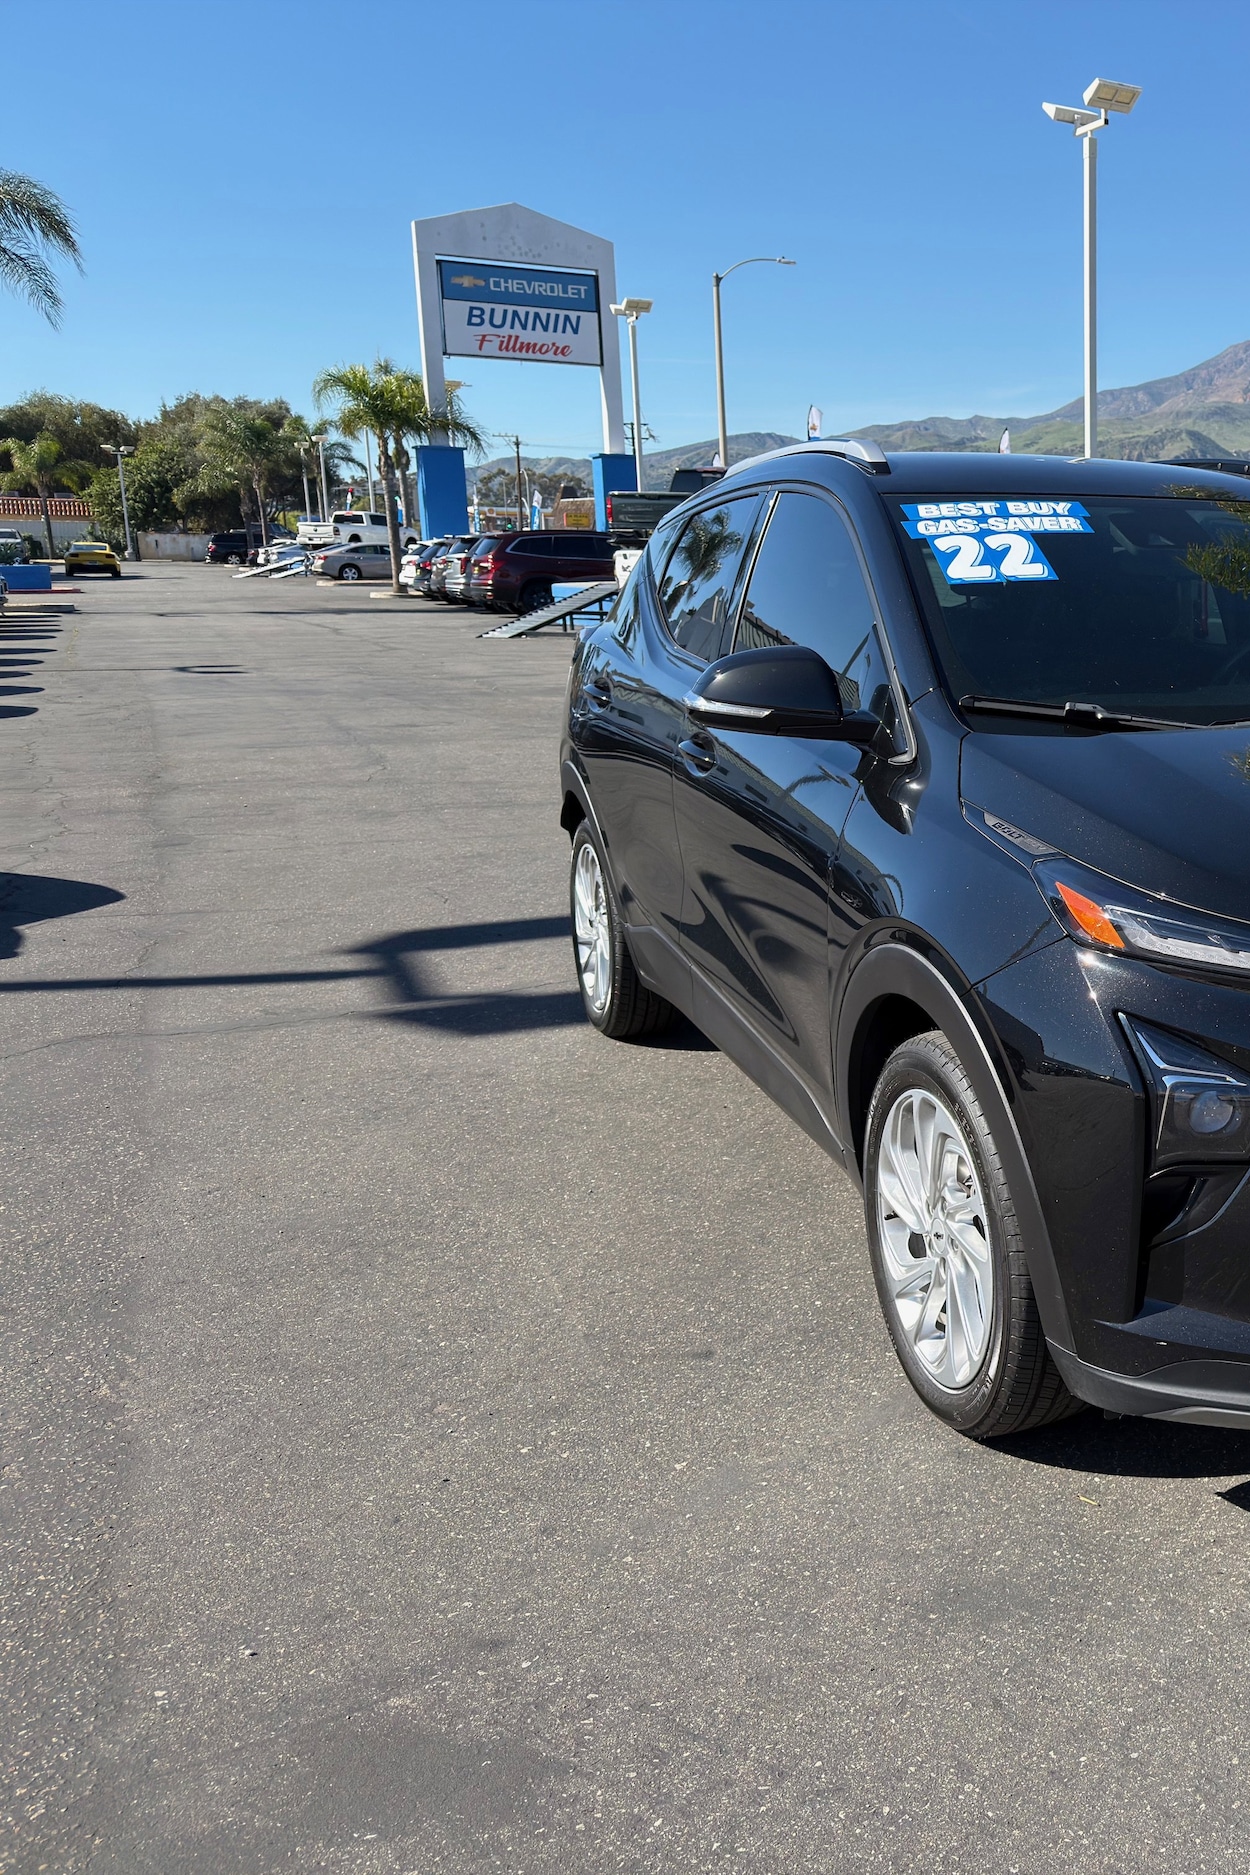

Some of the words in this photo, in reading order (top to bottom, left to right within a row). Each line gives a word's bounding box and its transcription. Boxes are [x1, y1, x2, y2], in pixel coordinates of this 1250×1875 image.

[489, 277, 588, 299] CHEVROLET
[466, 306, 582, 335] BUNNIN
[473, 333, 573, 358] Fillmore
[917, 501, 1000, 518] BEST
[1006, 501, 1072, 516] BUY
[916, 516, 1085, 535] GAS-SAVER
[933, 533, 1049, 580] 22
